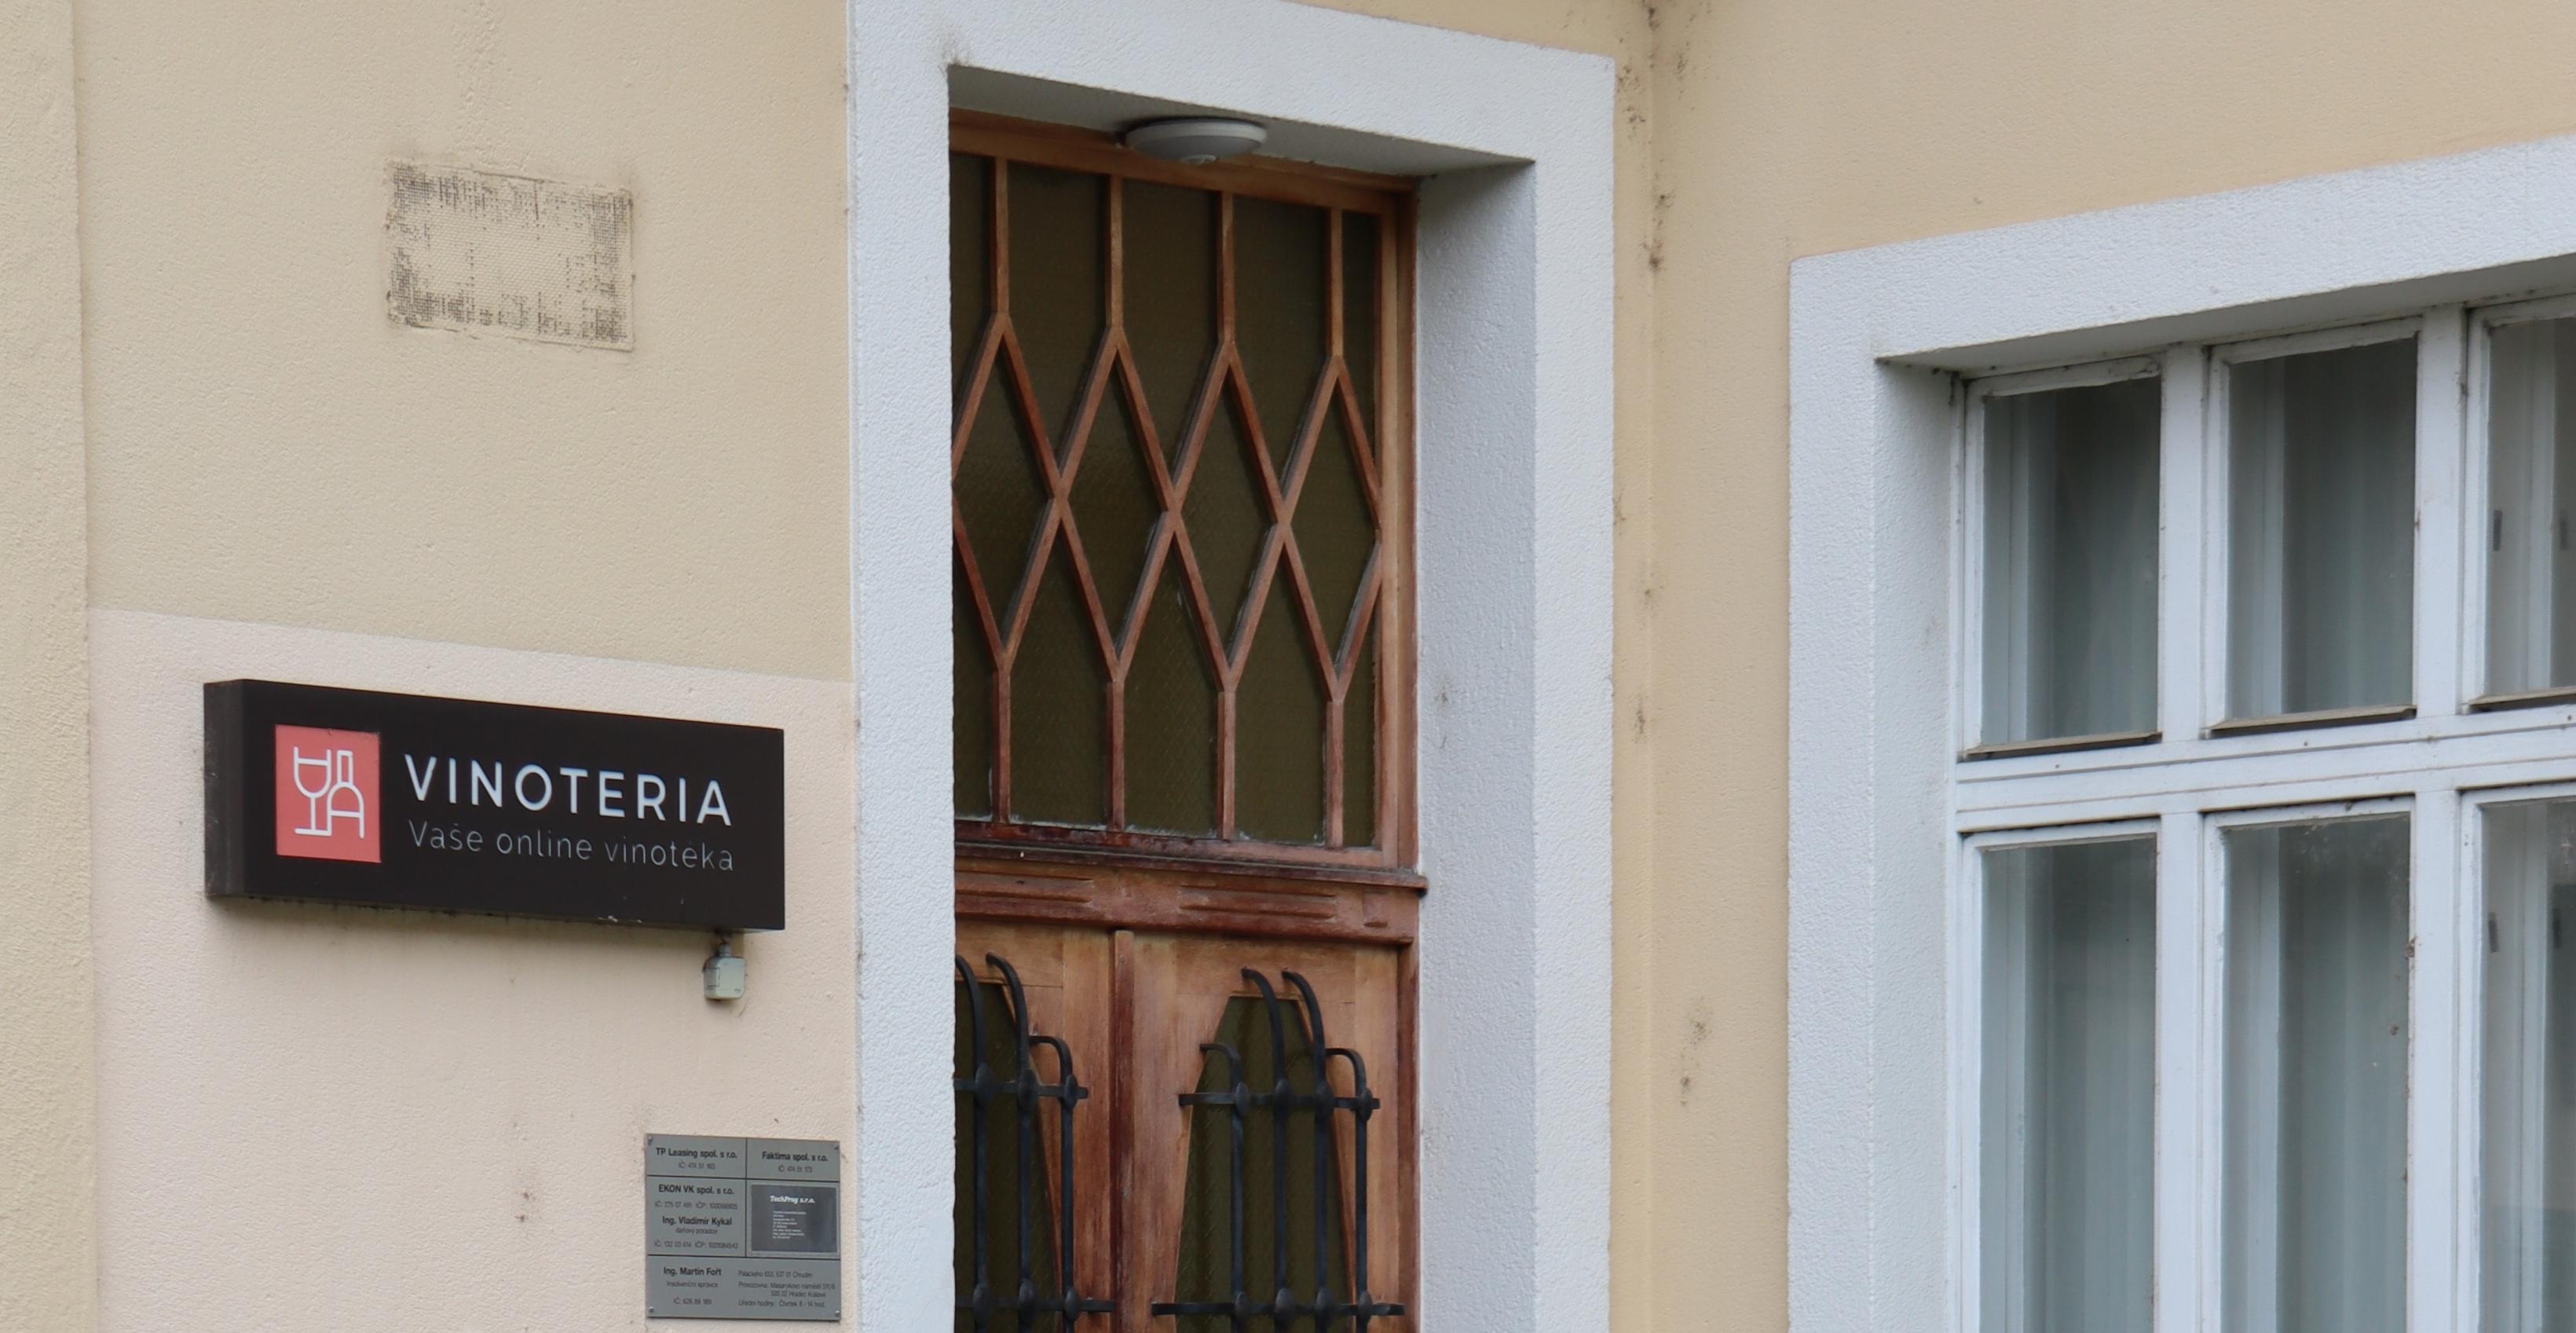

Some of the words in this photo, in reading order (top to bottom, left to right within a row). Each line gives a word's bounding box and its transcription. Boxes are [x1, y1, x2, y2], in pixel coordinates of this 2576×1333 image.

[404, 753, 732, 826] VINOTERIA
[408, 819, 484, 852] Vaše
[496, 829, 592, 861] online
[656, 1147, 666, 1156] TP
[668, 1148, 697, 1159] Leasing
[700, 1150, 718, 1159] spol.
[762, 1151, 791, 1160] Faktima
[792, 1152, 810, 1162] spol.
[659, 1184, 681, 1193] EKON
[683, 1185, 694, 1193] VK
[697, 1186, 715, 1195] spol.
[663, 1215, 676, 1226] Ing.
[712, 1217, 732, 1227] Kykal
[664, 1265, 677, 1276] Ing.
[679, 1266, 704, 1276] Martin
